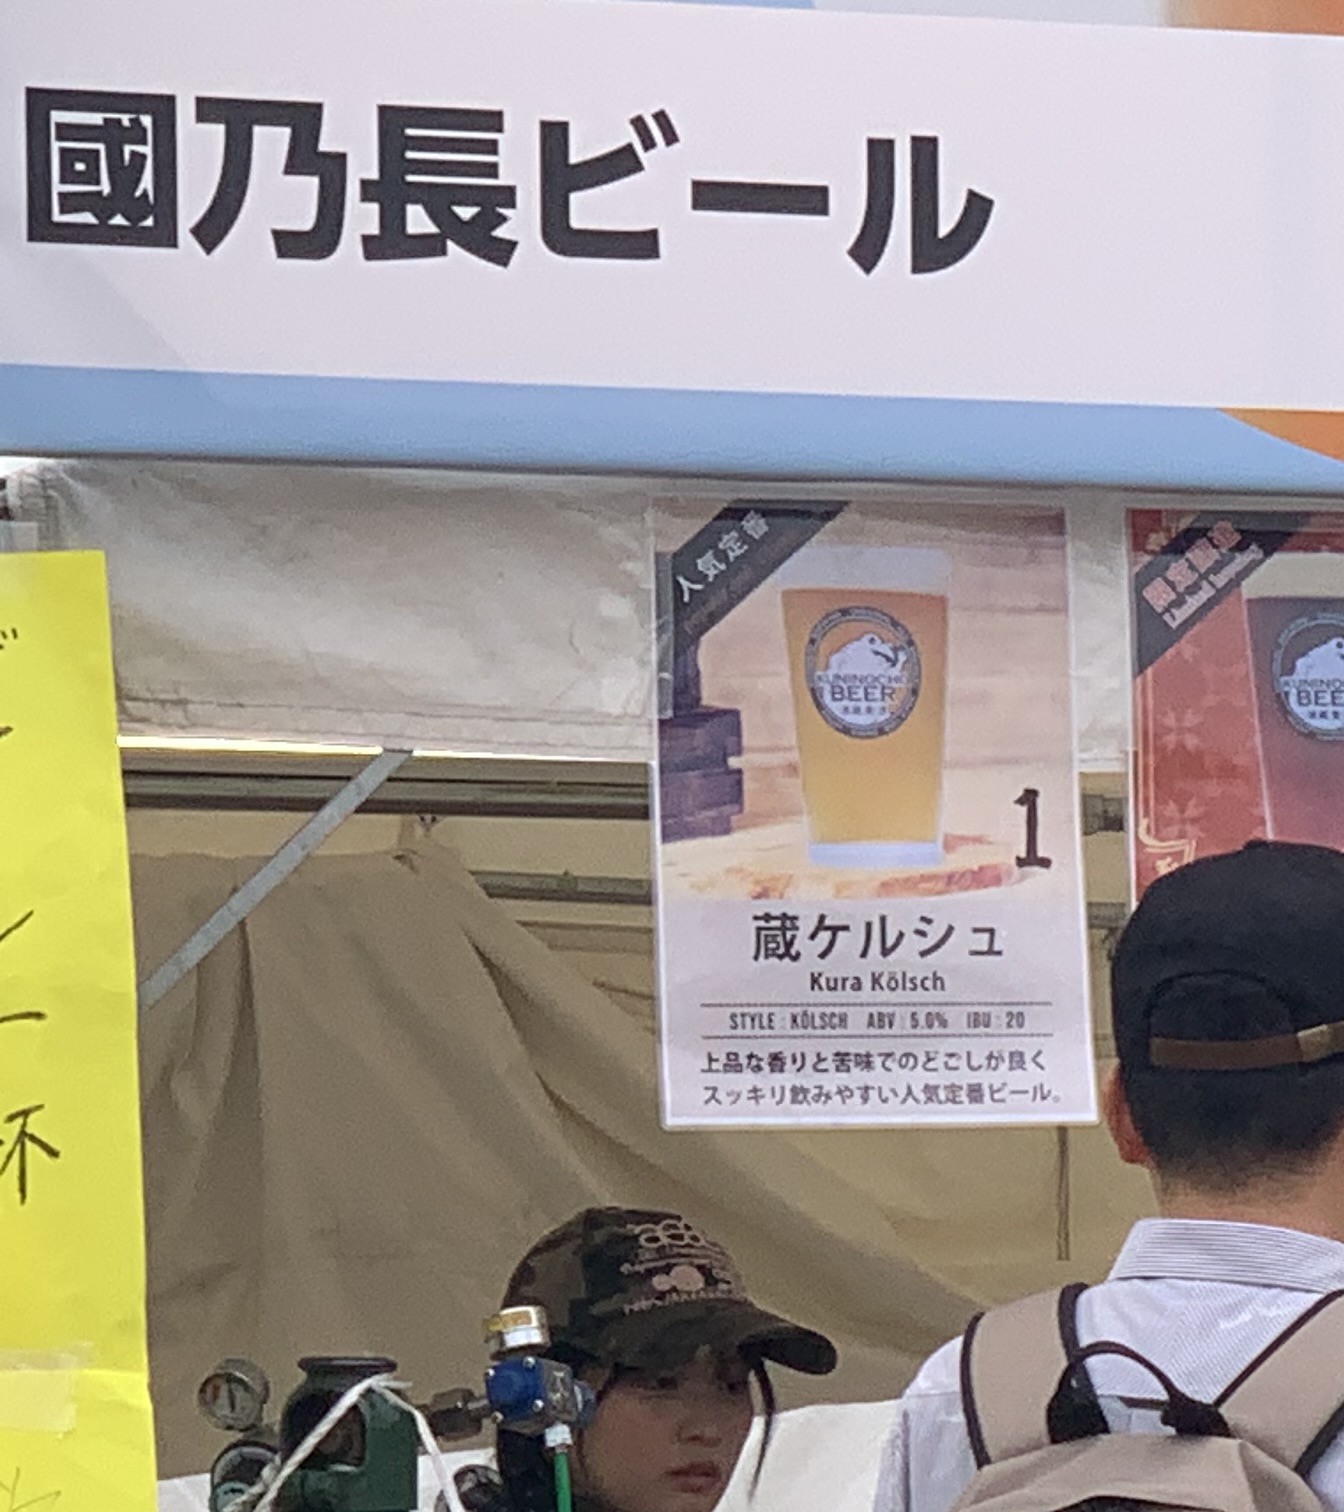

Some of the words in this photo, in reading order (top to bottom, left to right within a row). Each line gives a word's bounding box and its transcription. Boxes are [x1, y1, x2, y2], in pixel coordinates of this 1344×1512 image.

[25, 86, 994, 275] 國乃長ビール
[677, 510, 769, 602] 人気定番
[831, 685, 896, 702] BEER
[1014, 788, 1052, 869] 1
[752, 913, 1005, 963] 蔵ケルシュ
[810, 972, 863, 993] Kura
[871, 971, 946, 993] Kölsch
[867, 1012, 896, 1030] ABV
